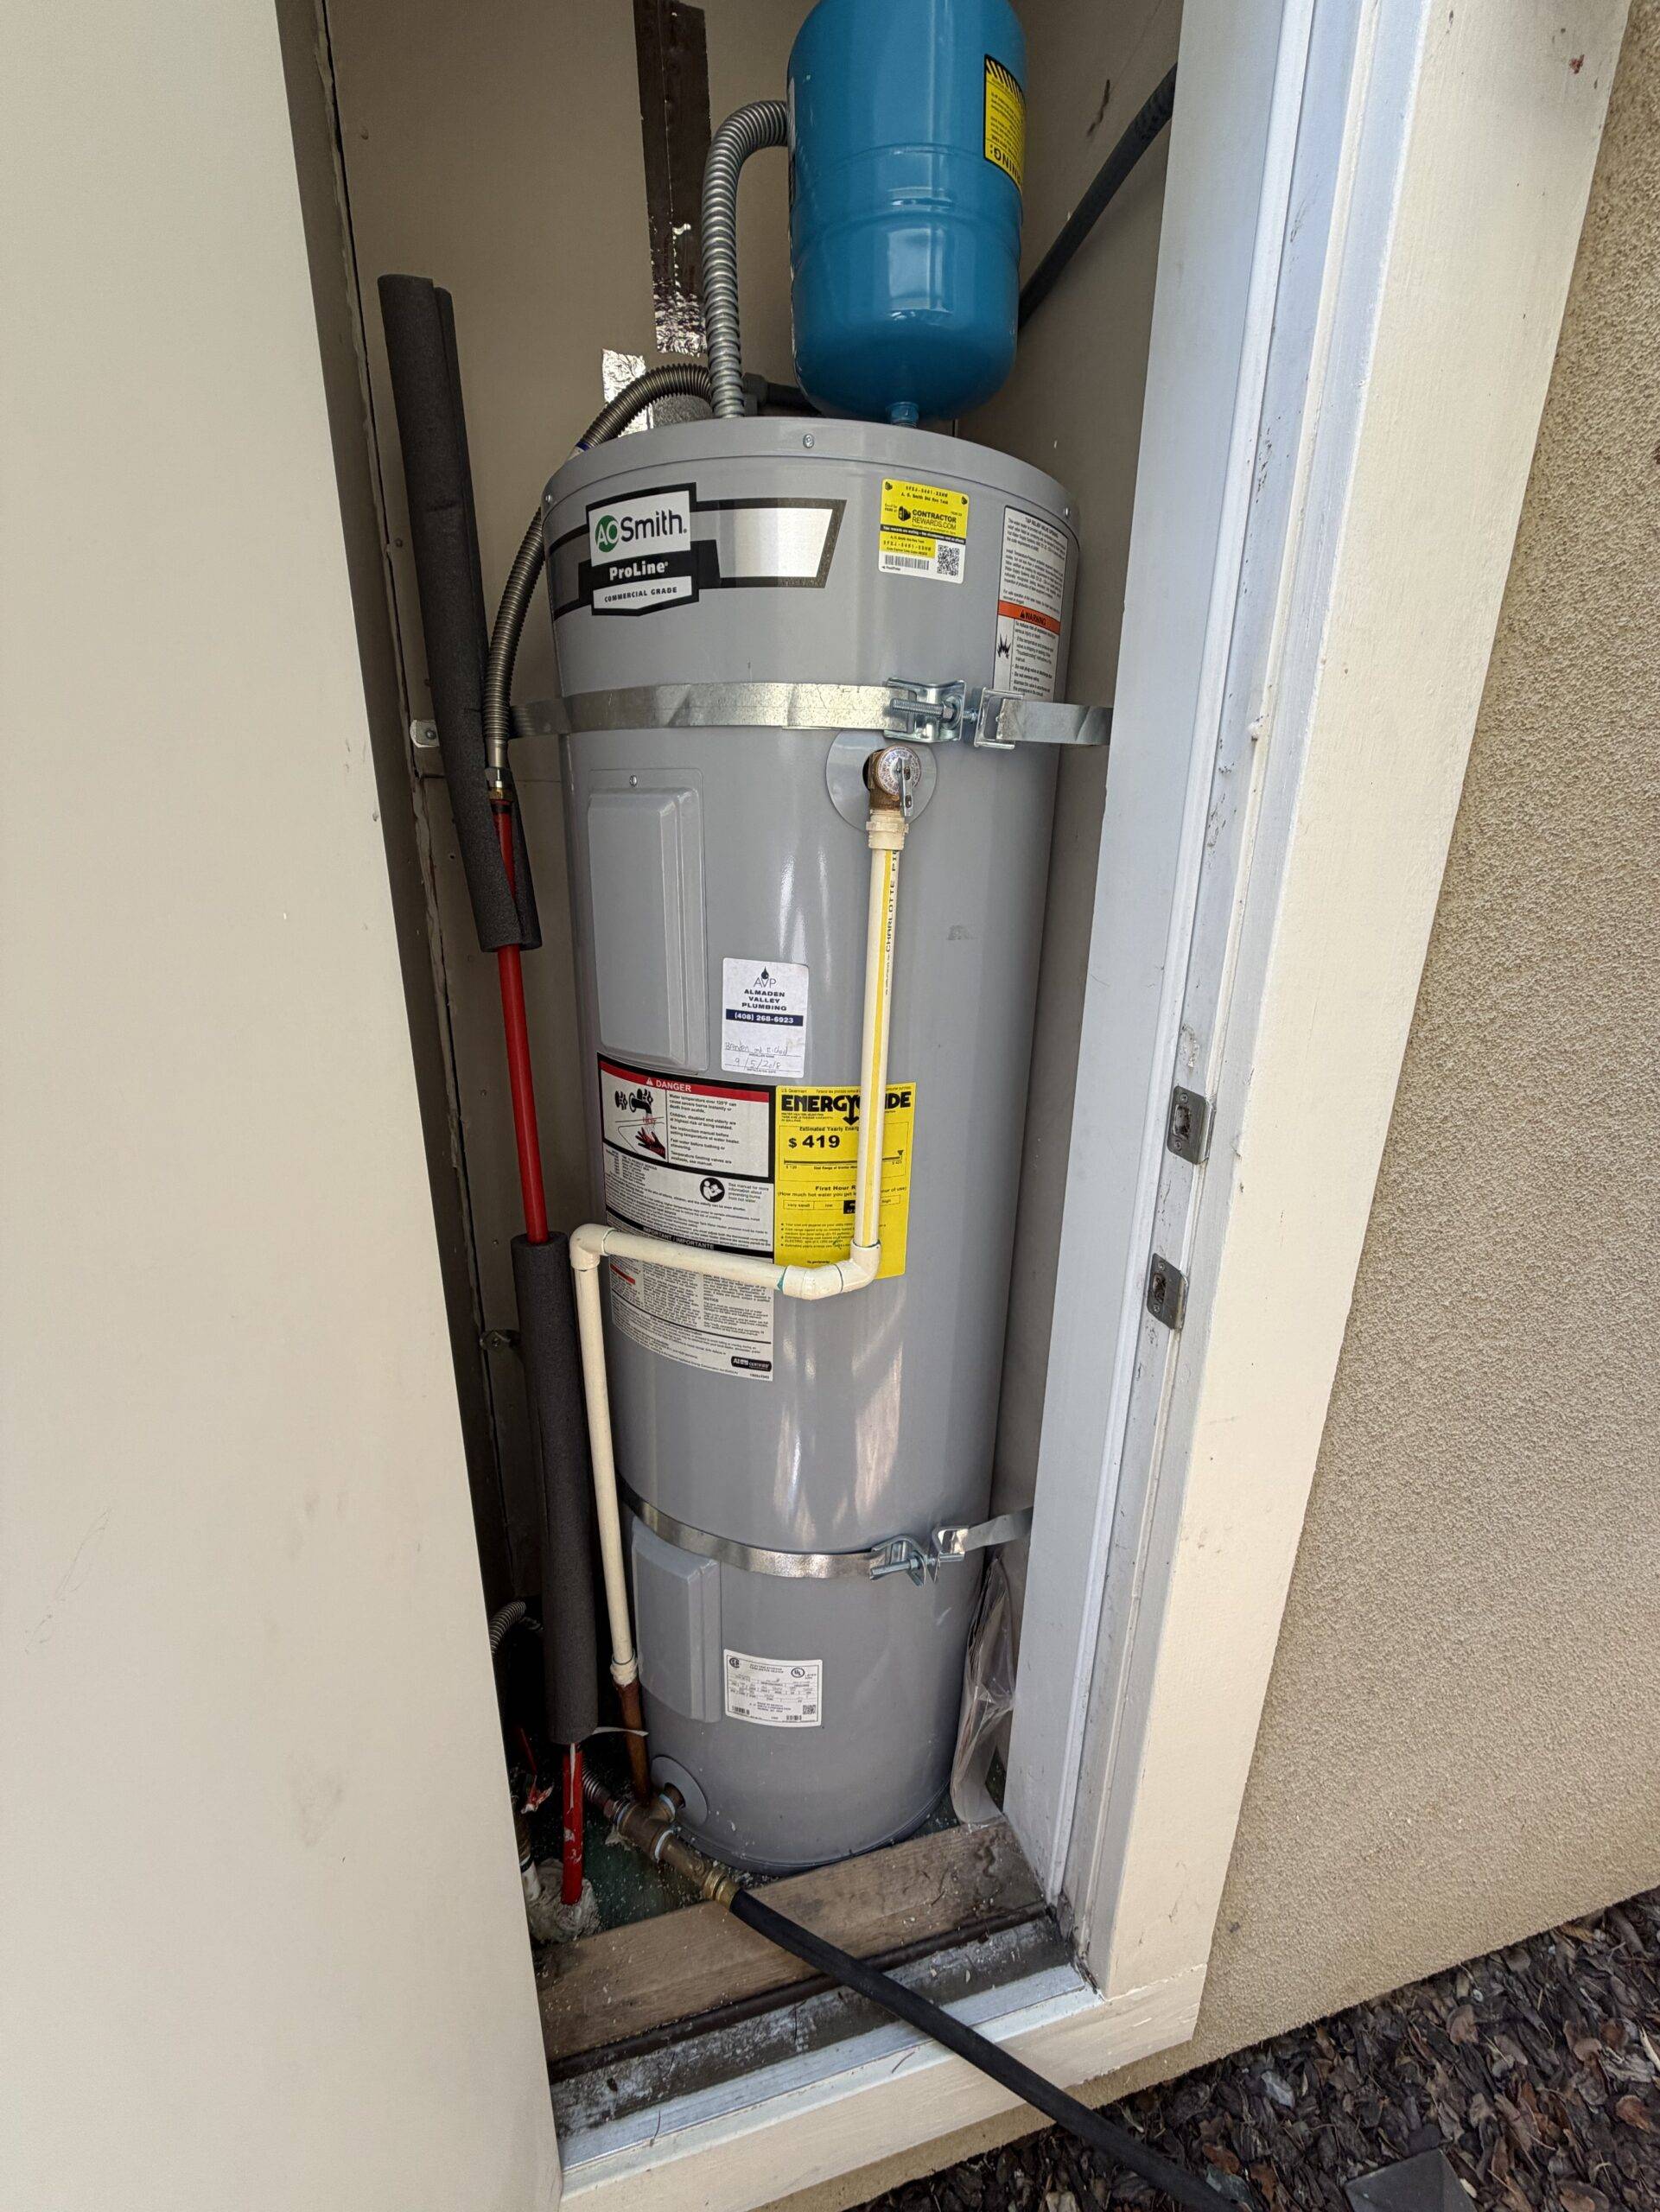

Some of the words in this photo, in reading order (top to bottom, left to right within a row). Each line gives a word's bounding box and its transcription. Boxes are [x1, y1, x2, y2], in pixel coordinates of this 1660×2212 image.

[912, 509, 957, 523] CONTRACTOR
[912, 517, 957, 531] REWARDS.COM
[605, 590, 647, 602] COMMERCIAL
[651, 587, 677, 595] GRADE
[1025, 612, 1046, 625] WARNING
[885, 880, 895, 952] CHARLOTTE
[754, 977, 777, 988] AVP
[744, 988, 785, 997] ALMADEN
[741, 1002, 787, 1011] PLUMBING
[735, 1012, 754, 1021] (408)
[756, 1014, 794, 1024] 268-6923
[656, 1080, 691, 1092] DANGER
[788, 1137, 798, 1148] $
[802, 1135, 840, 1148] 419
[643, 1226, 672, 1241] IMPORTANT
[676, 1236, 715, 1250] IMPORTANTE
